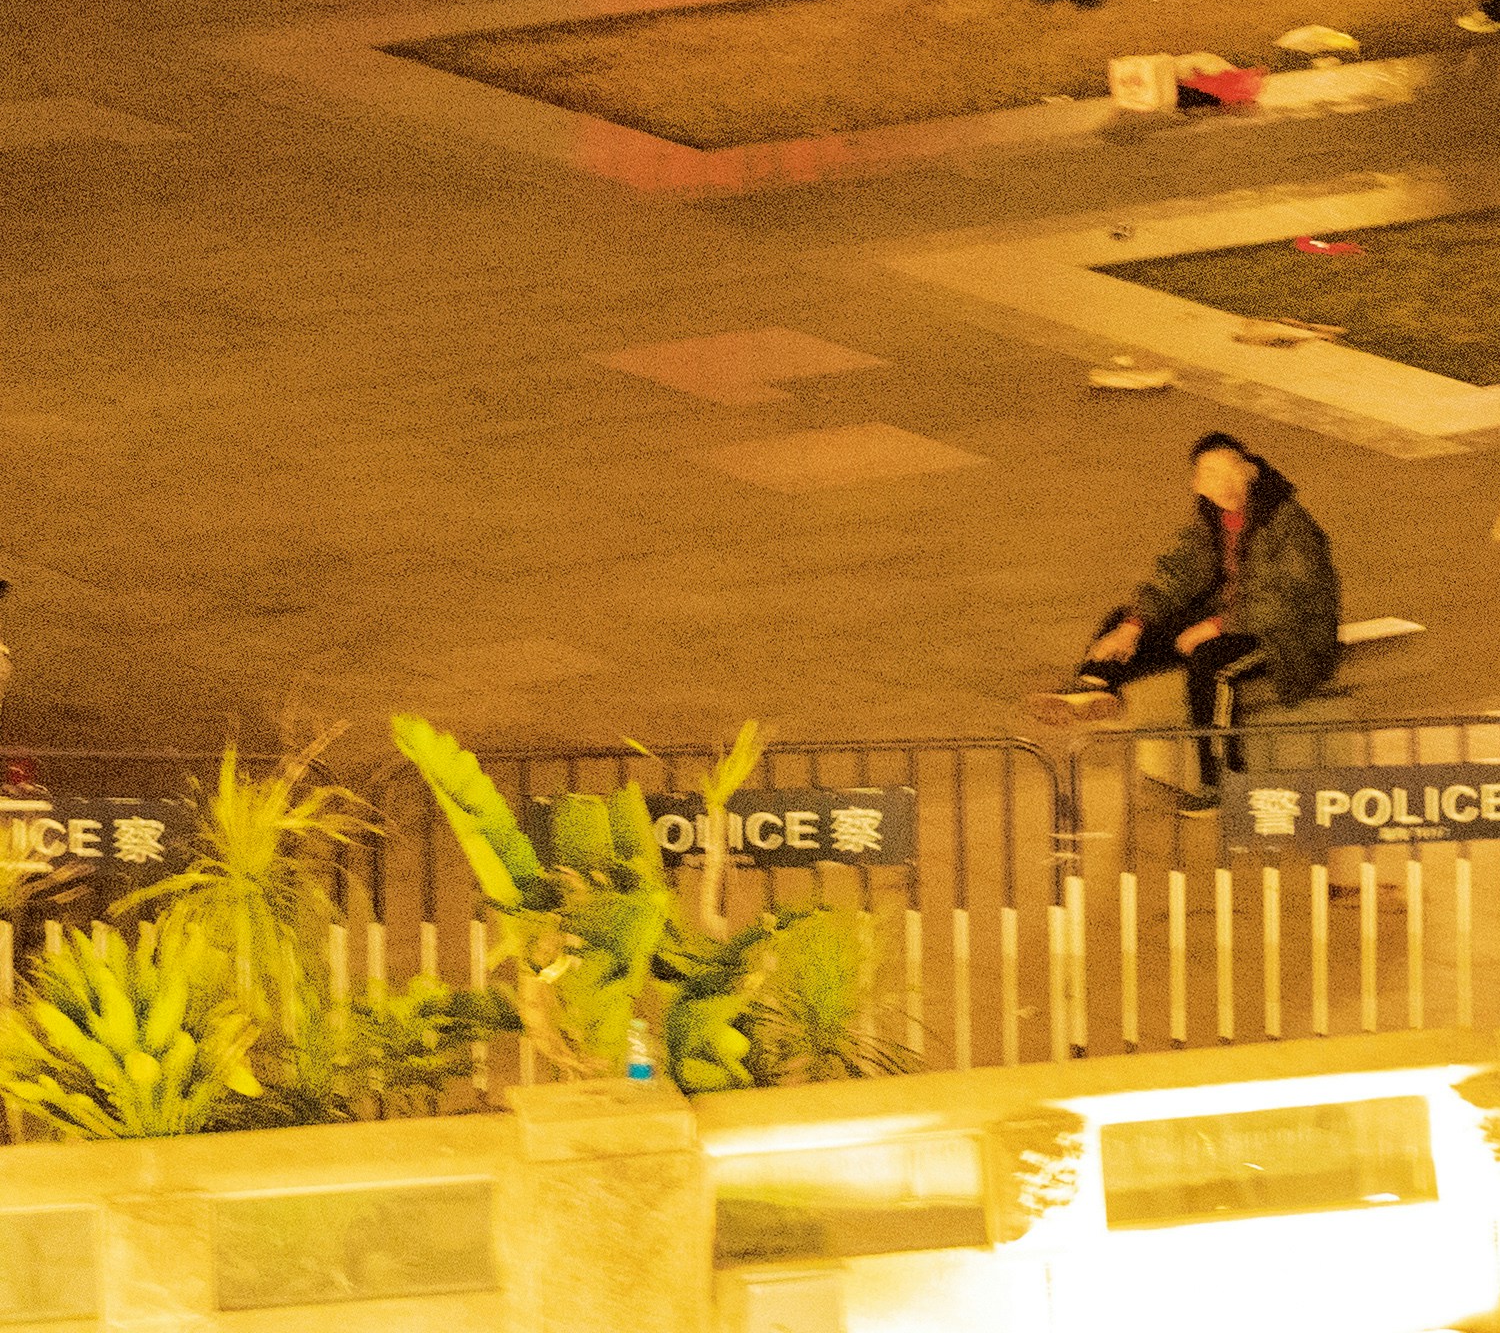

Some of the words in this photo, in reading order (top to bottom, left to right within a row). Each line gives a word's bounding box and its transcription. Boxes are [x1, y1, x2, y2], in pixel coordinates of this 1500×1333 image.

[830, 805, 883, 853] 察
[1248, 788, 1300, 836] 警
[113, 816, 165, 863] 察
